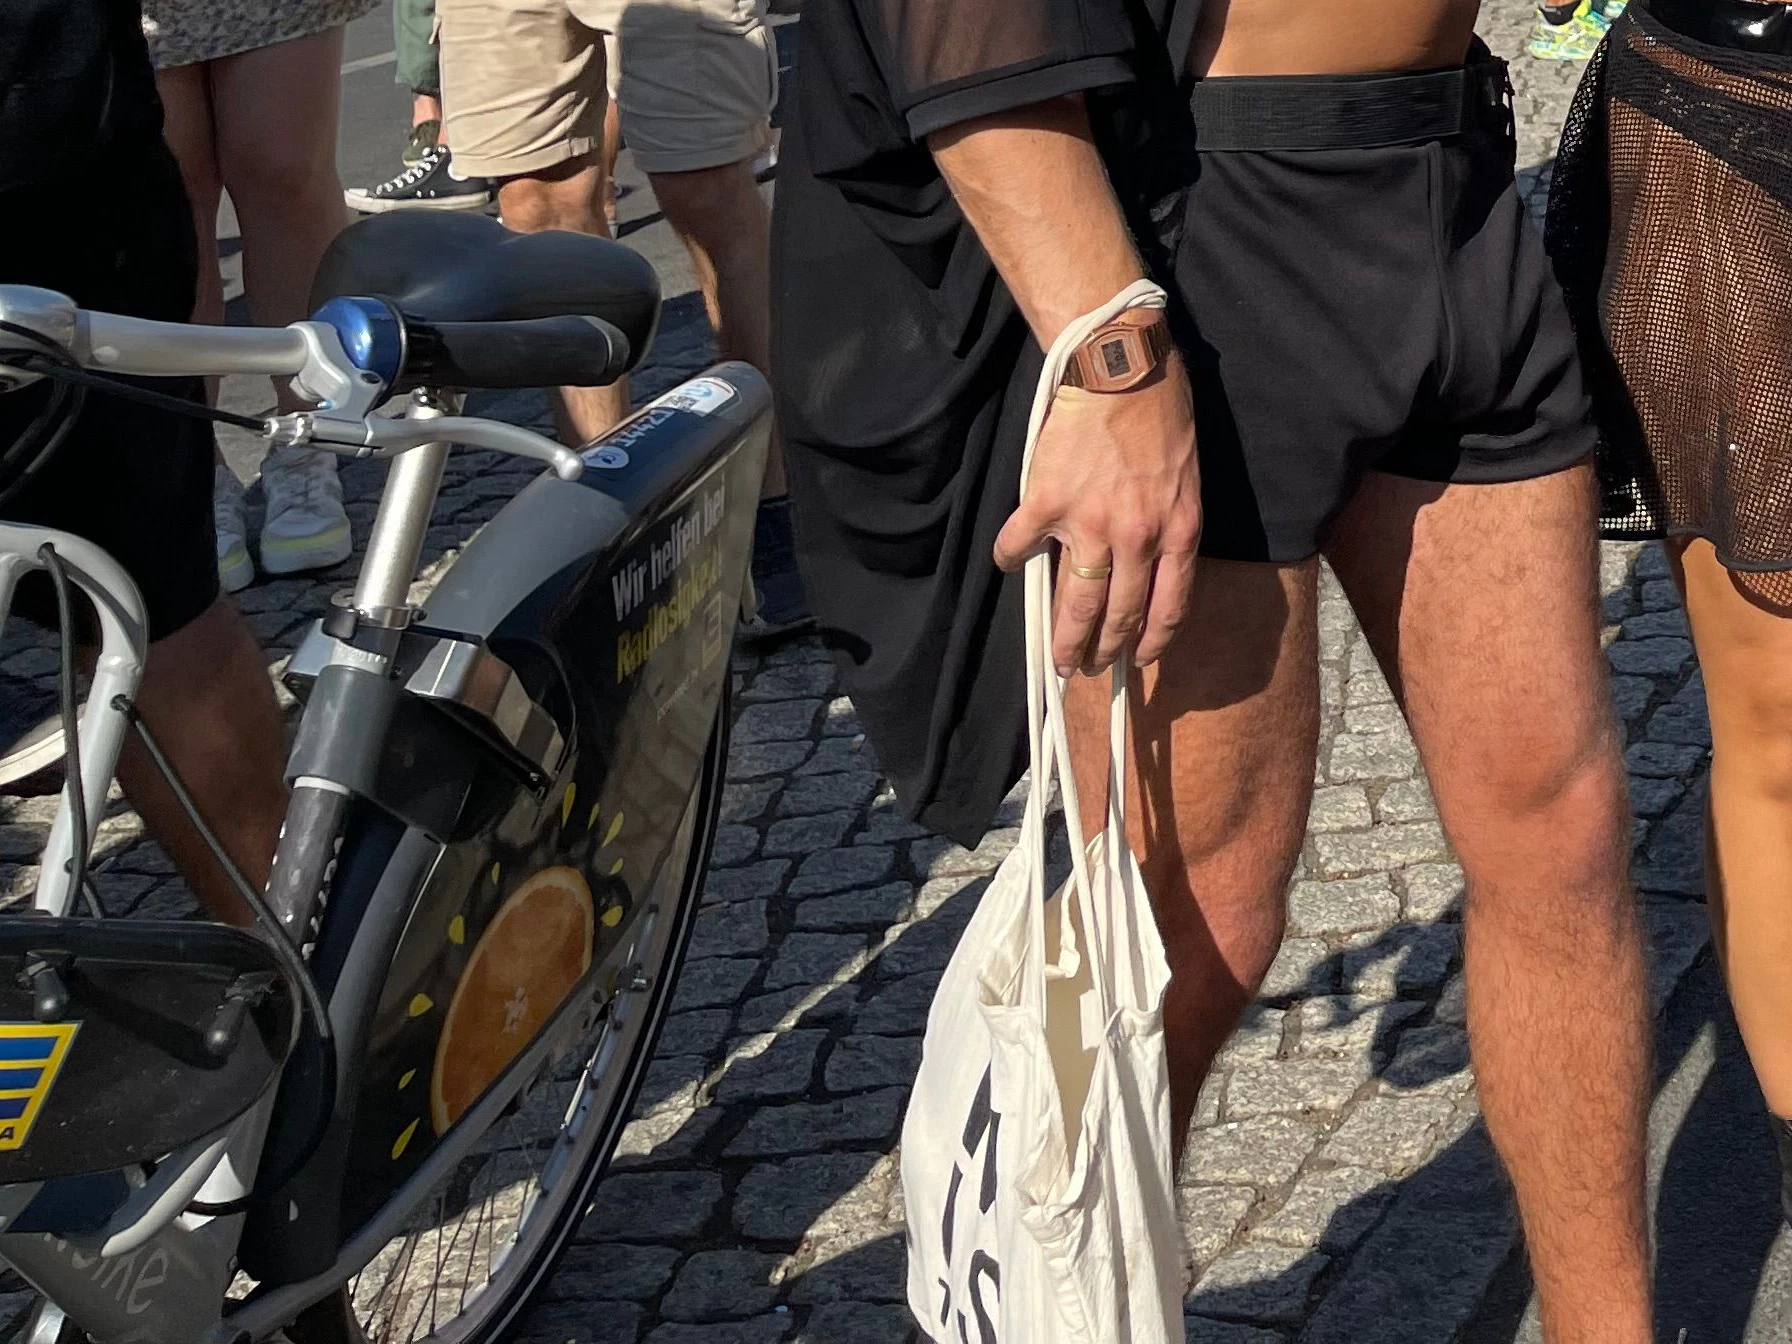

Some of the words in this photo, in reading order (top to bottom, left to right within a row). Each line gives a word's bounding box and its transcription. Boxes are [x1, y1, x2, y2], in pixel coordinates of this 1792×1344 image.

[612, 556, 649, 622] Wir
[651, 511, 700, 592] helfen
[703, 472, 726, 537] bei
